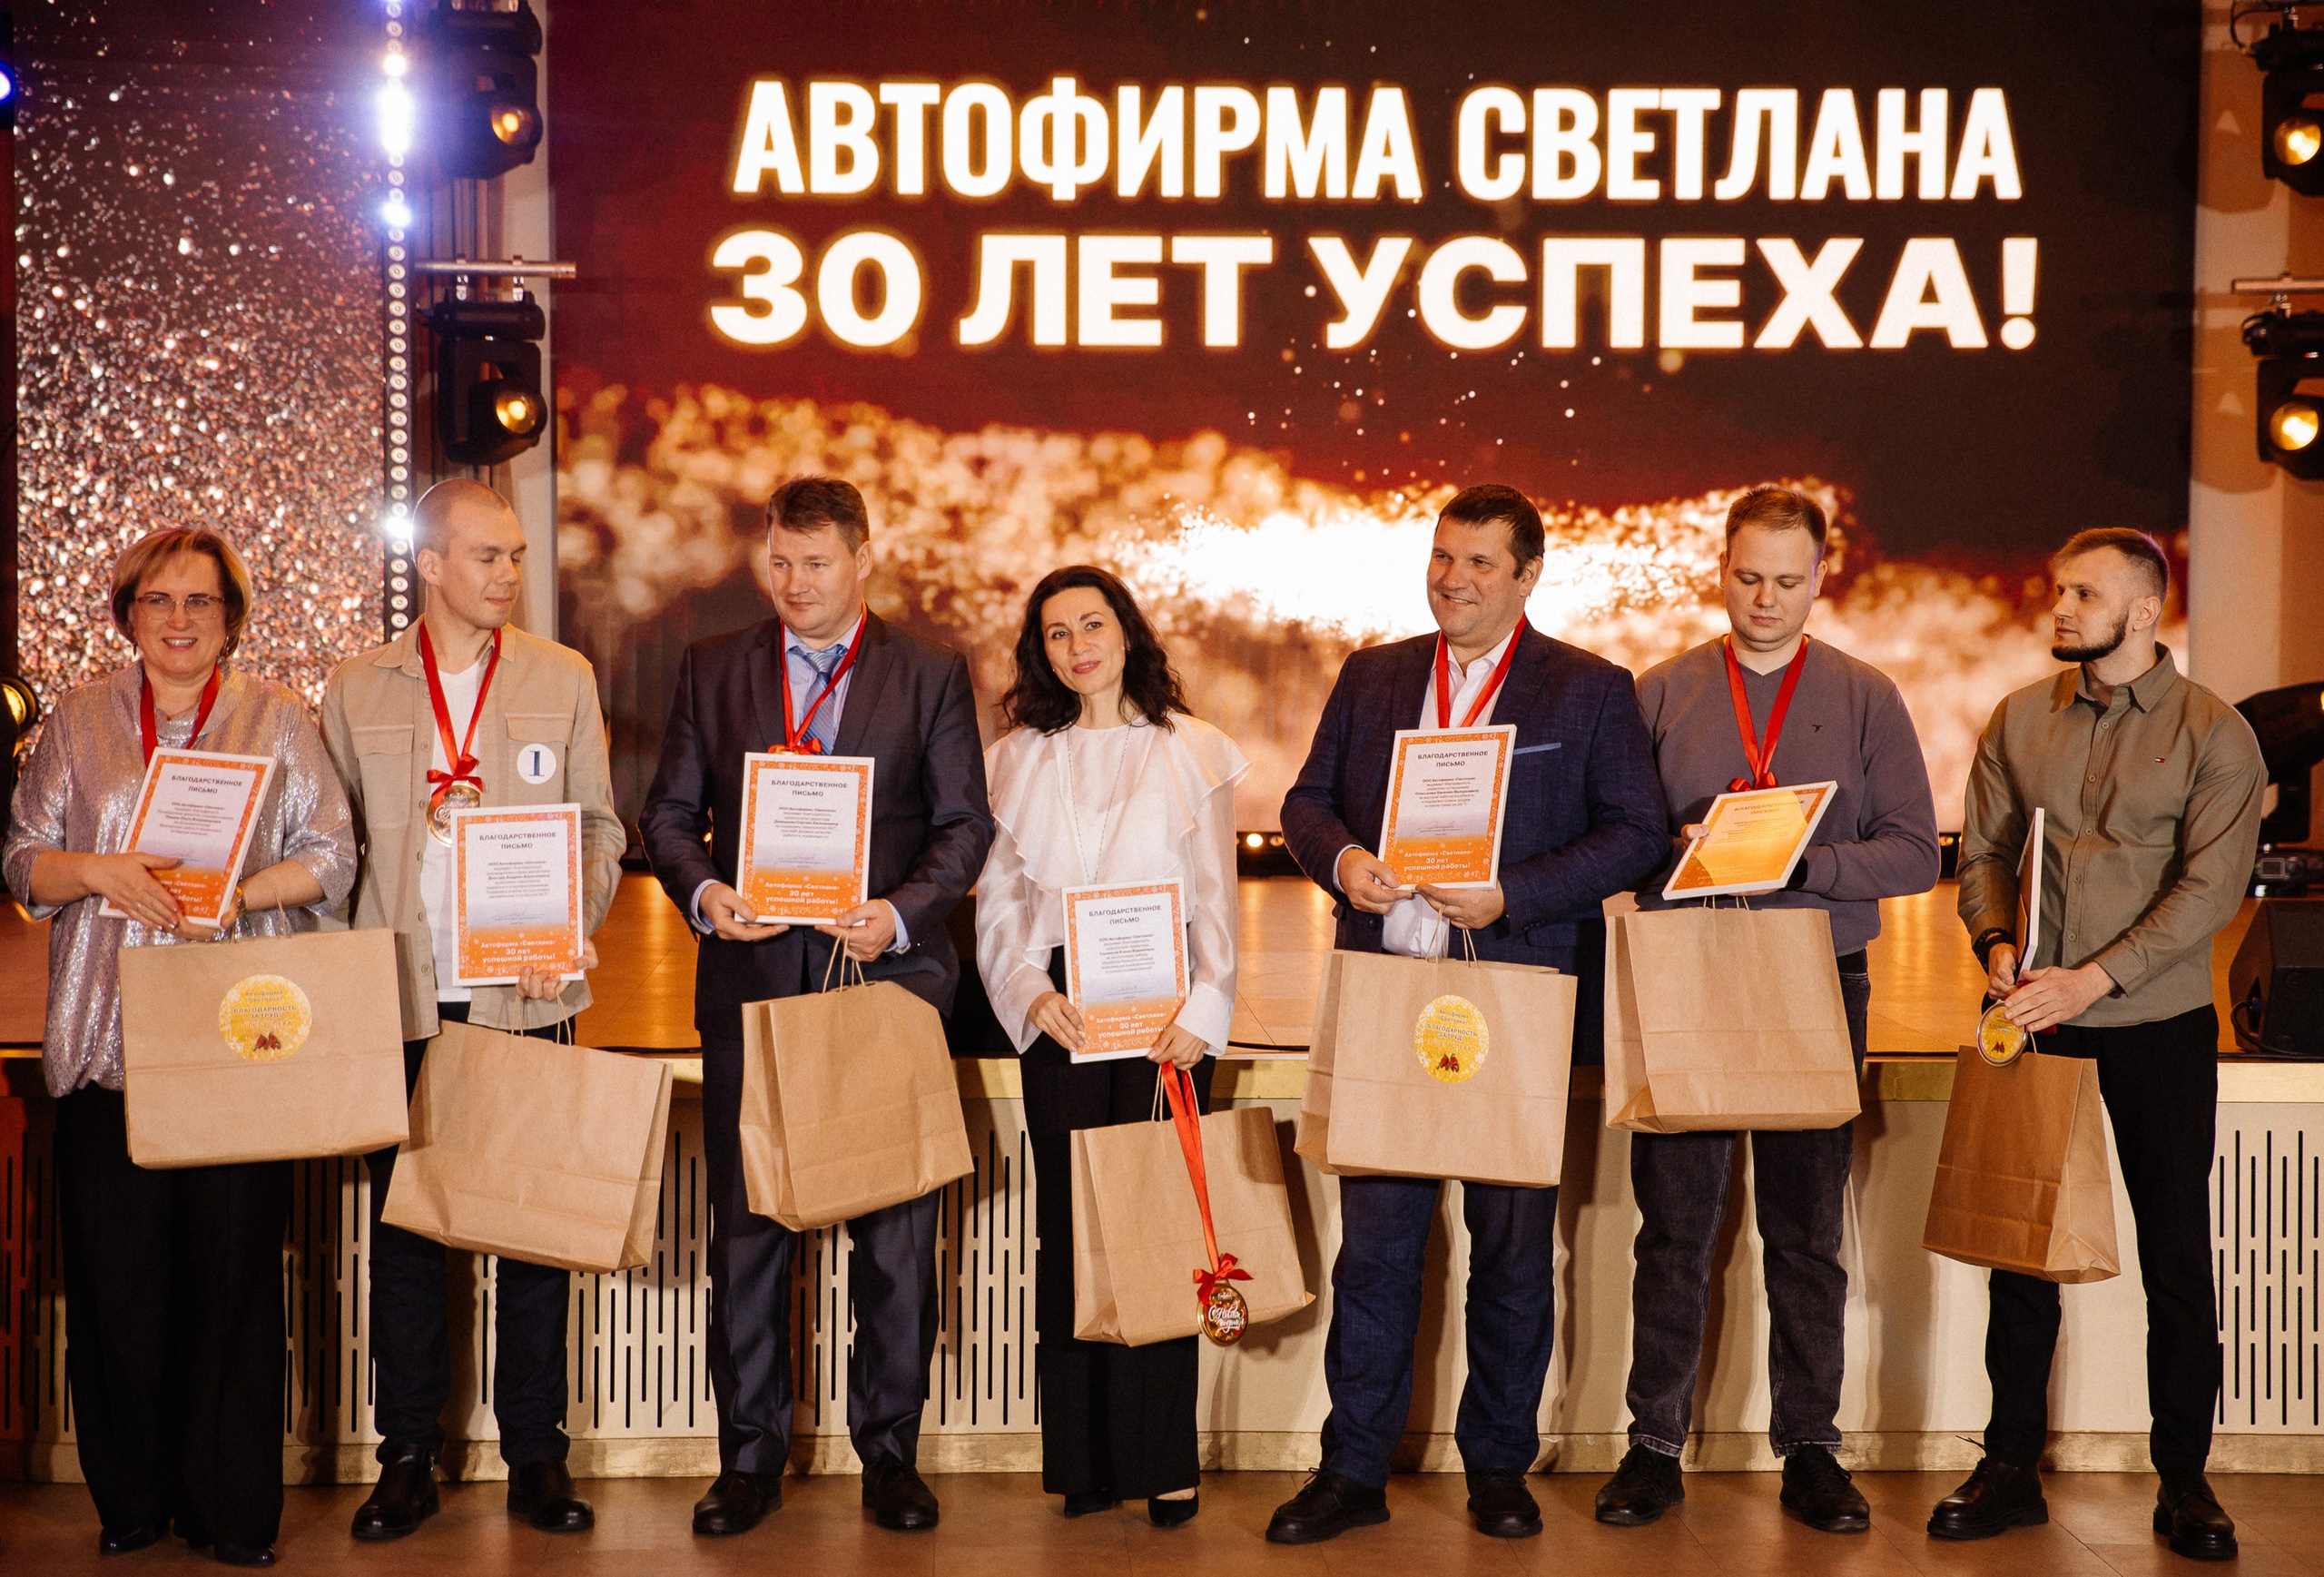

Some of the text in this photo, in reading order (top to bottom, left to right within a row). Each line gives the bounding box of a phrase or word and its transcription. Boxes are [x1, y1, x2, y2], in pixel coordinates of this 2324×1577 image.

[733, 78, 2022, 201] АВТОФИРМА СВЕТЛАНА
[711, 231, 2036, 350] 30 ЛЕТ УСПЕХА!
[1417, 750, 1489, 760] БЛАГОДАРСТВЕННОЕ
[172, 774, 243, 787] БЛАГОДАРСТВЕННОЕ
[771, 780, 848, 789] БЛАГОДАРСТВЕННОЕ
[188, 786, 218, 794] ПИСЬМО
[479, 832, 556, 841] БЛАГОДАРСТВЕННОЕ
[1403, 862, 1471, 872] успешной работы!
[805, 896, 838, 905] работы!
[1088, 904, 1162, 917] БЛАГОДАРСТВЕННОЕ
[1109, 916, 1140, 925] ПИСЬМО
[482, 953, 556, 964] успешной работы!
[233, 1005, 296, 1014] БЛАГОДАРНОСТЬ
[1096, 1015, 1132, 1024] Автофирма
[1098, 1029, 1136, 1040] успешной
[1427, 1023, 1478, 1037] БЛАГОДАРНОСТЬ
